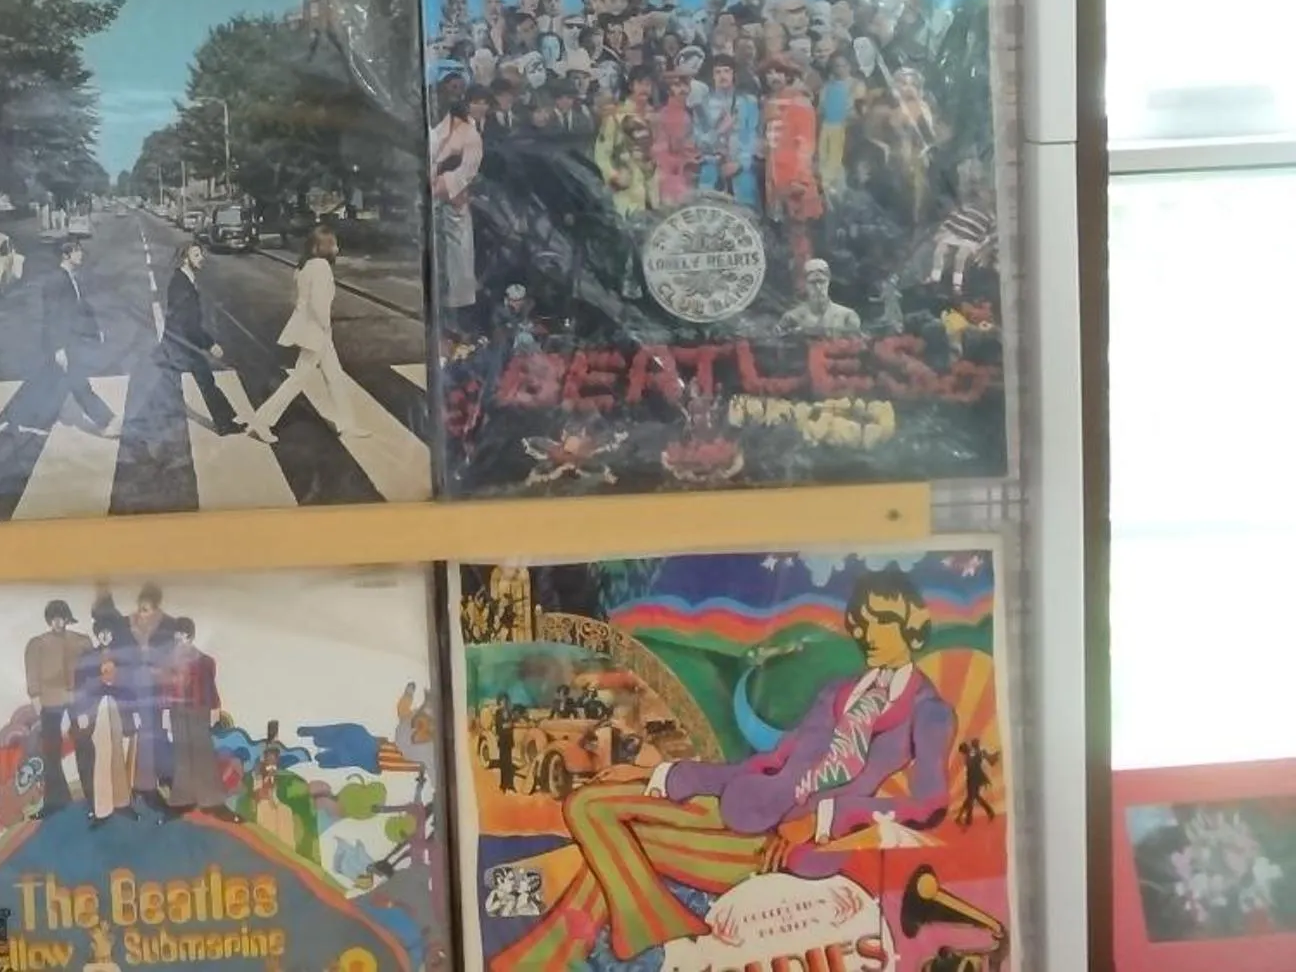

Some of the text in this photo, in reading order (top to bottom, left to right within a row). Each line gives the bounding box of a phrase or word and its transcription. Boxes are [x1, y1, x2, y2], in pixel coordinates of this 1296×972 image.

[495, 335, 940, 413] BEATLES
[13, 865, 279, 931] The Beatles
[123, 925, 286, 966] Submarine
